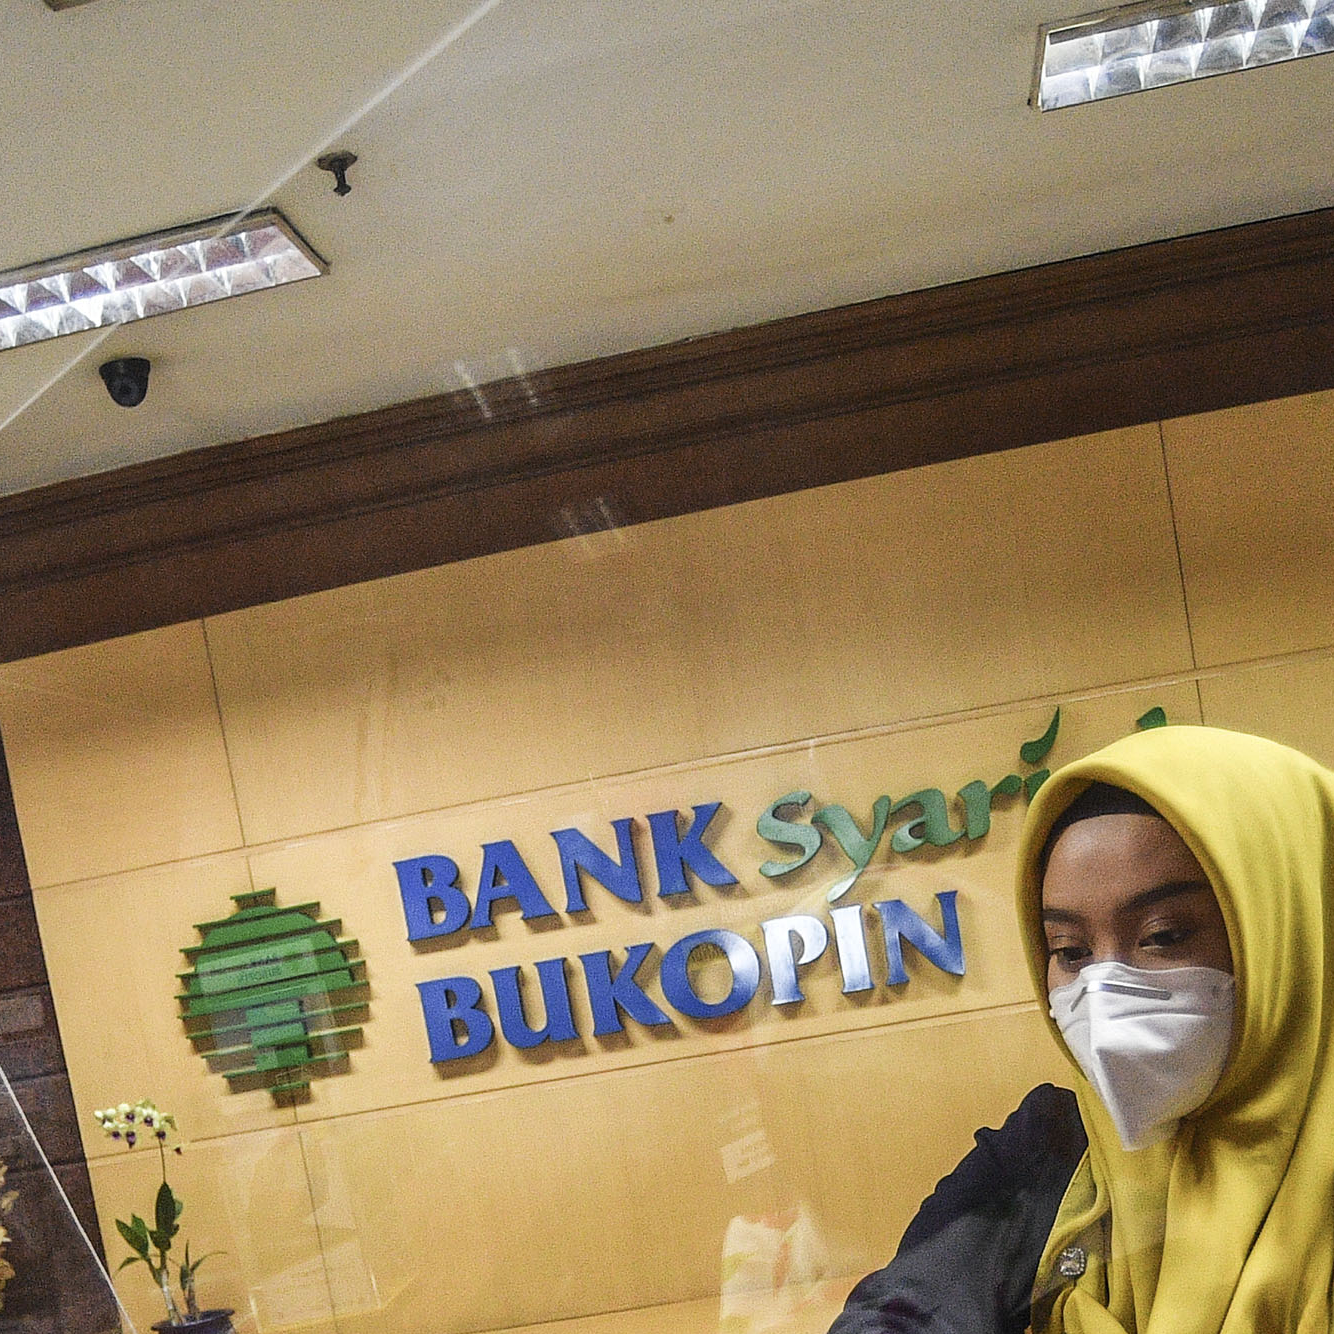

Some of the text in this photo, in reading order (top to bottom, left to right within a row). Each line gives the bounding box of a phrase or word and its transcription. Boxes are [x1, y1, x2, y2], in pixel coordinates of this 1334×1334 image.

[392, 705, 1167, 944] BANK Syari
[416, 889, 966, 1064] BUKOPIN
